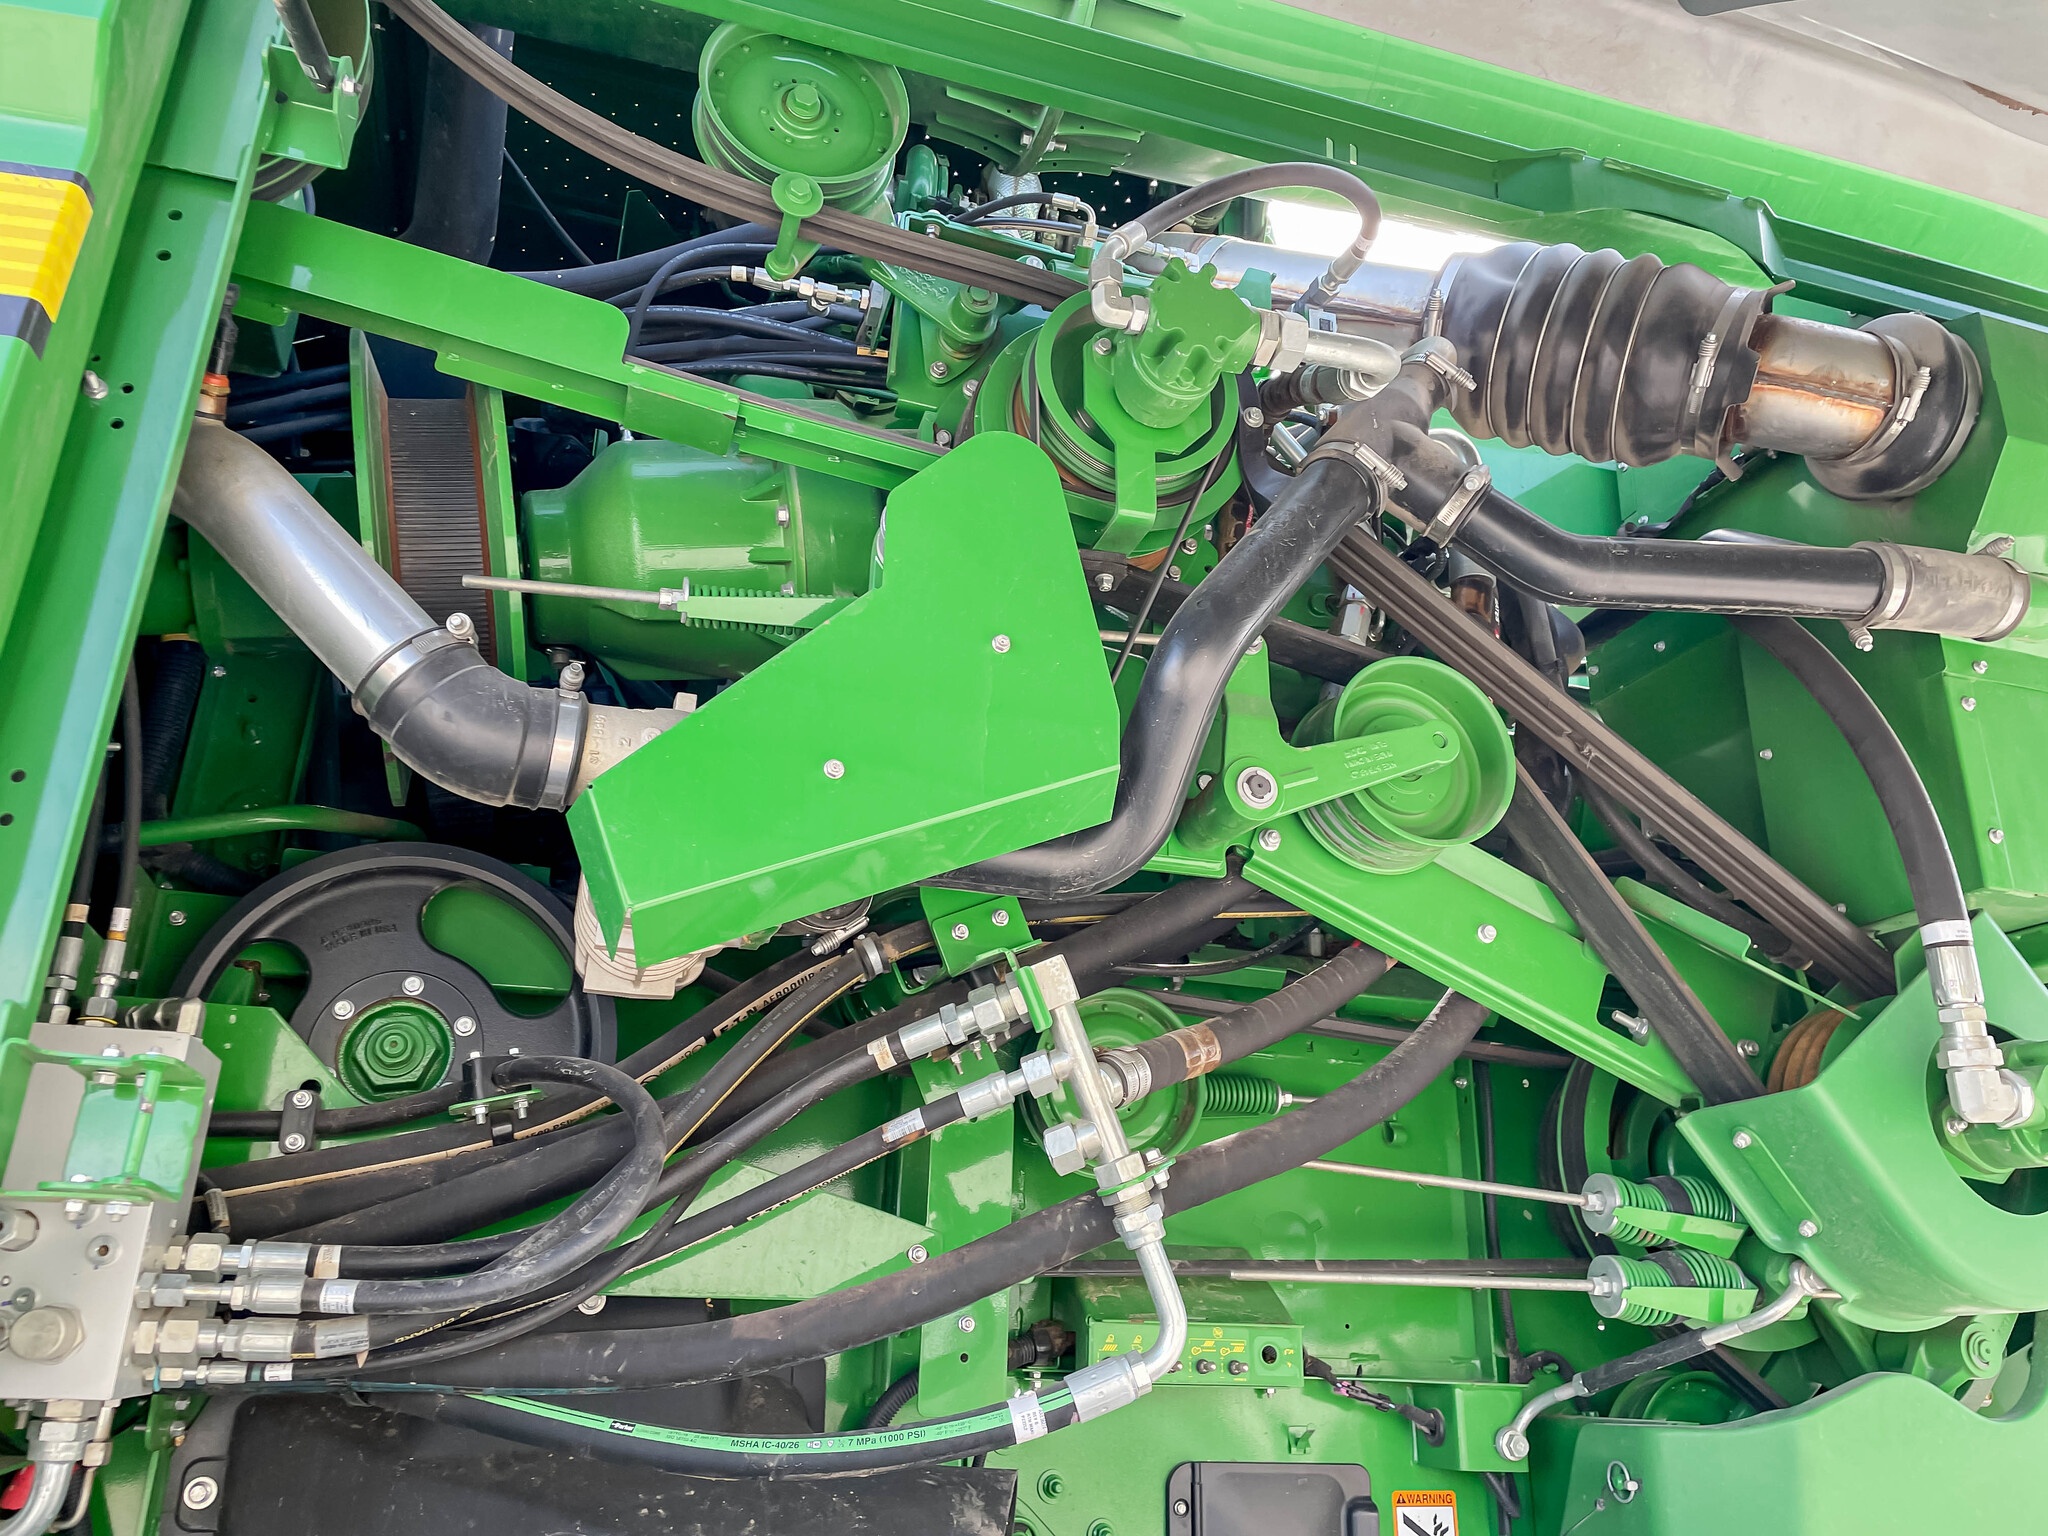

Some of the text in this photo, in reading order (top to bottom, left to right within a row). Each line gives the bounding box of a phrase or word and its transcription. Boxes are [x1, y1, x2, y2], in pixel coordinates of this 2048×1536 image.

[611, 1422, 635, 1432] Parker
[730, 1439, 759, 1448] MSHA
[761, 1440, 800, 1449] IC-40/26
[848, 1439, 854, 1447] 7
[856, 1437, 877, 1446] MPa
[879, 1433, 905, 1444] (1000
[907, 1430, 926, 1440] PSI)
[1406, 1493, 1453, 1504] WARNING
